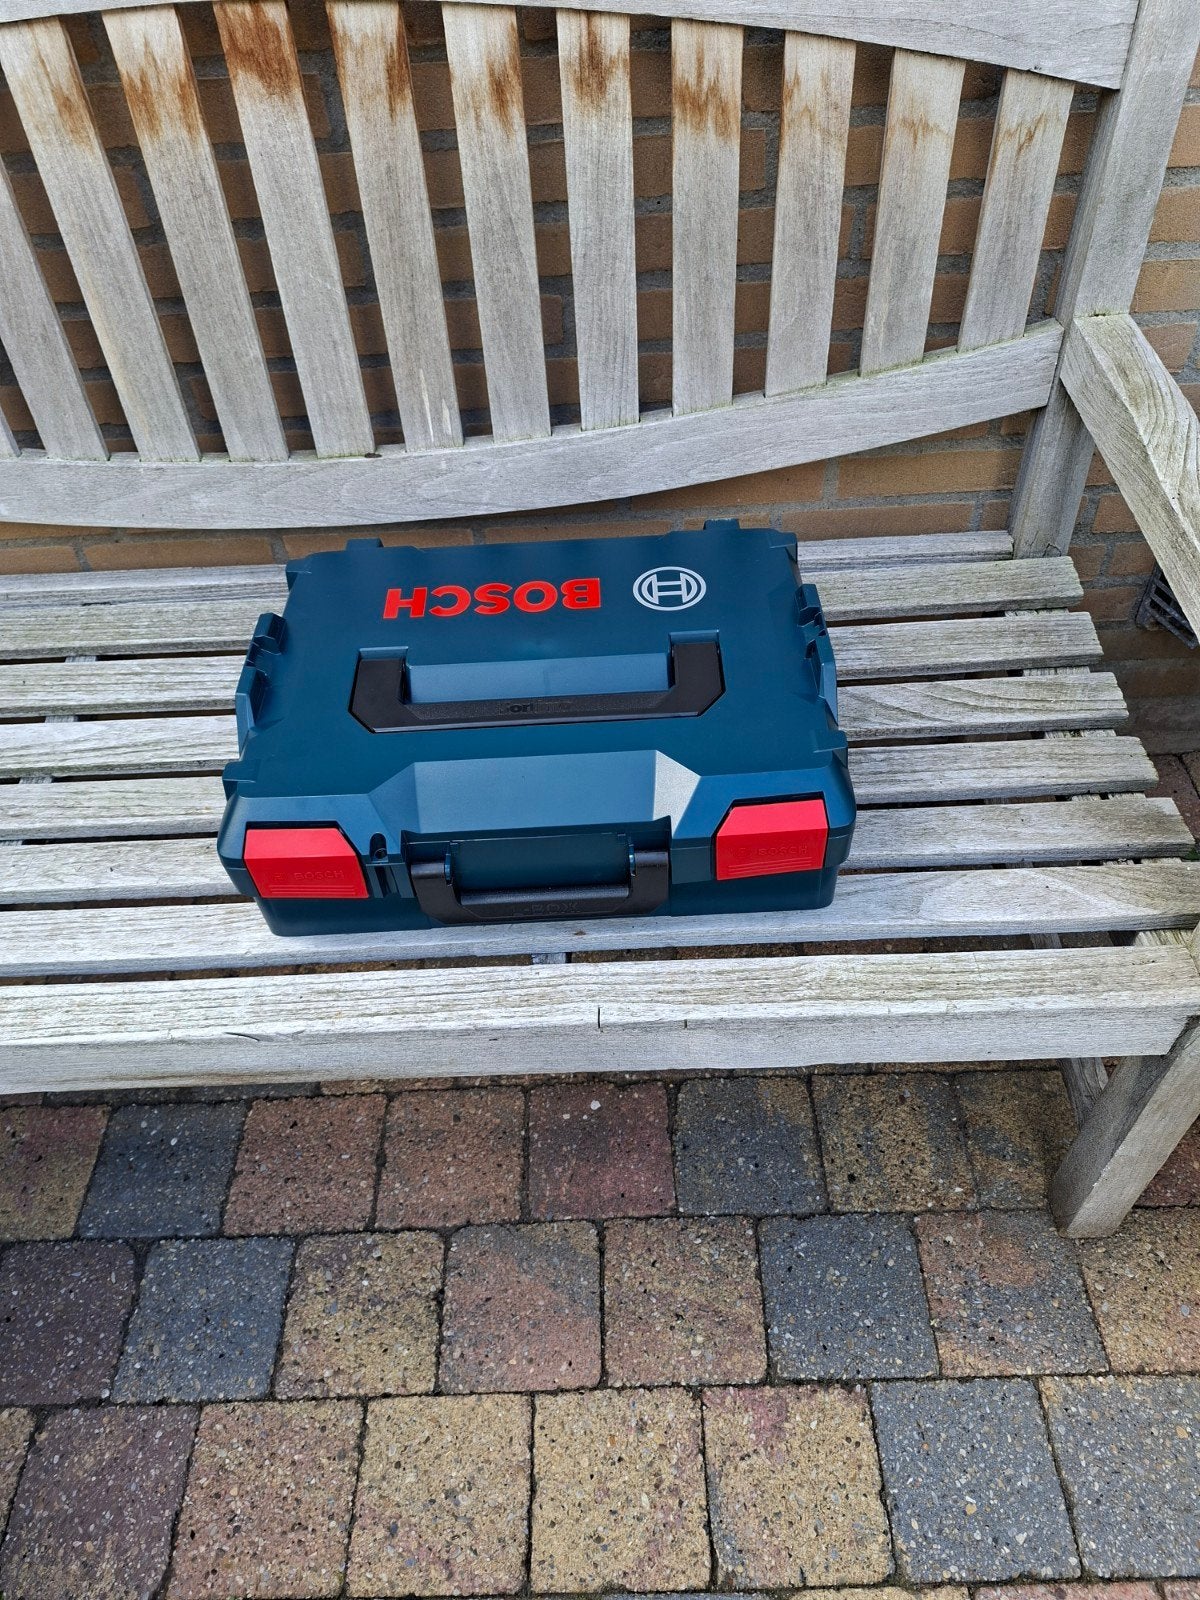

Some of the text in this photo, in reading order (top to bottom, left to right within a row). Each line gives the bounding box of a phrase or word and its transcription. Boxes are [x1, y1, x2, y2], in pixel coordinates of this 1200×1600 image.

[383, 577, 601, 619] BOSCH
[757, 843, 808, 857] BOSCH
[293, 870, 345, 882] BOSCH
